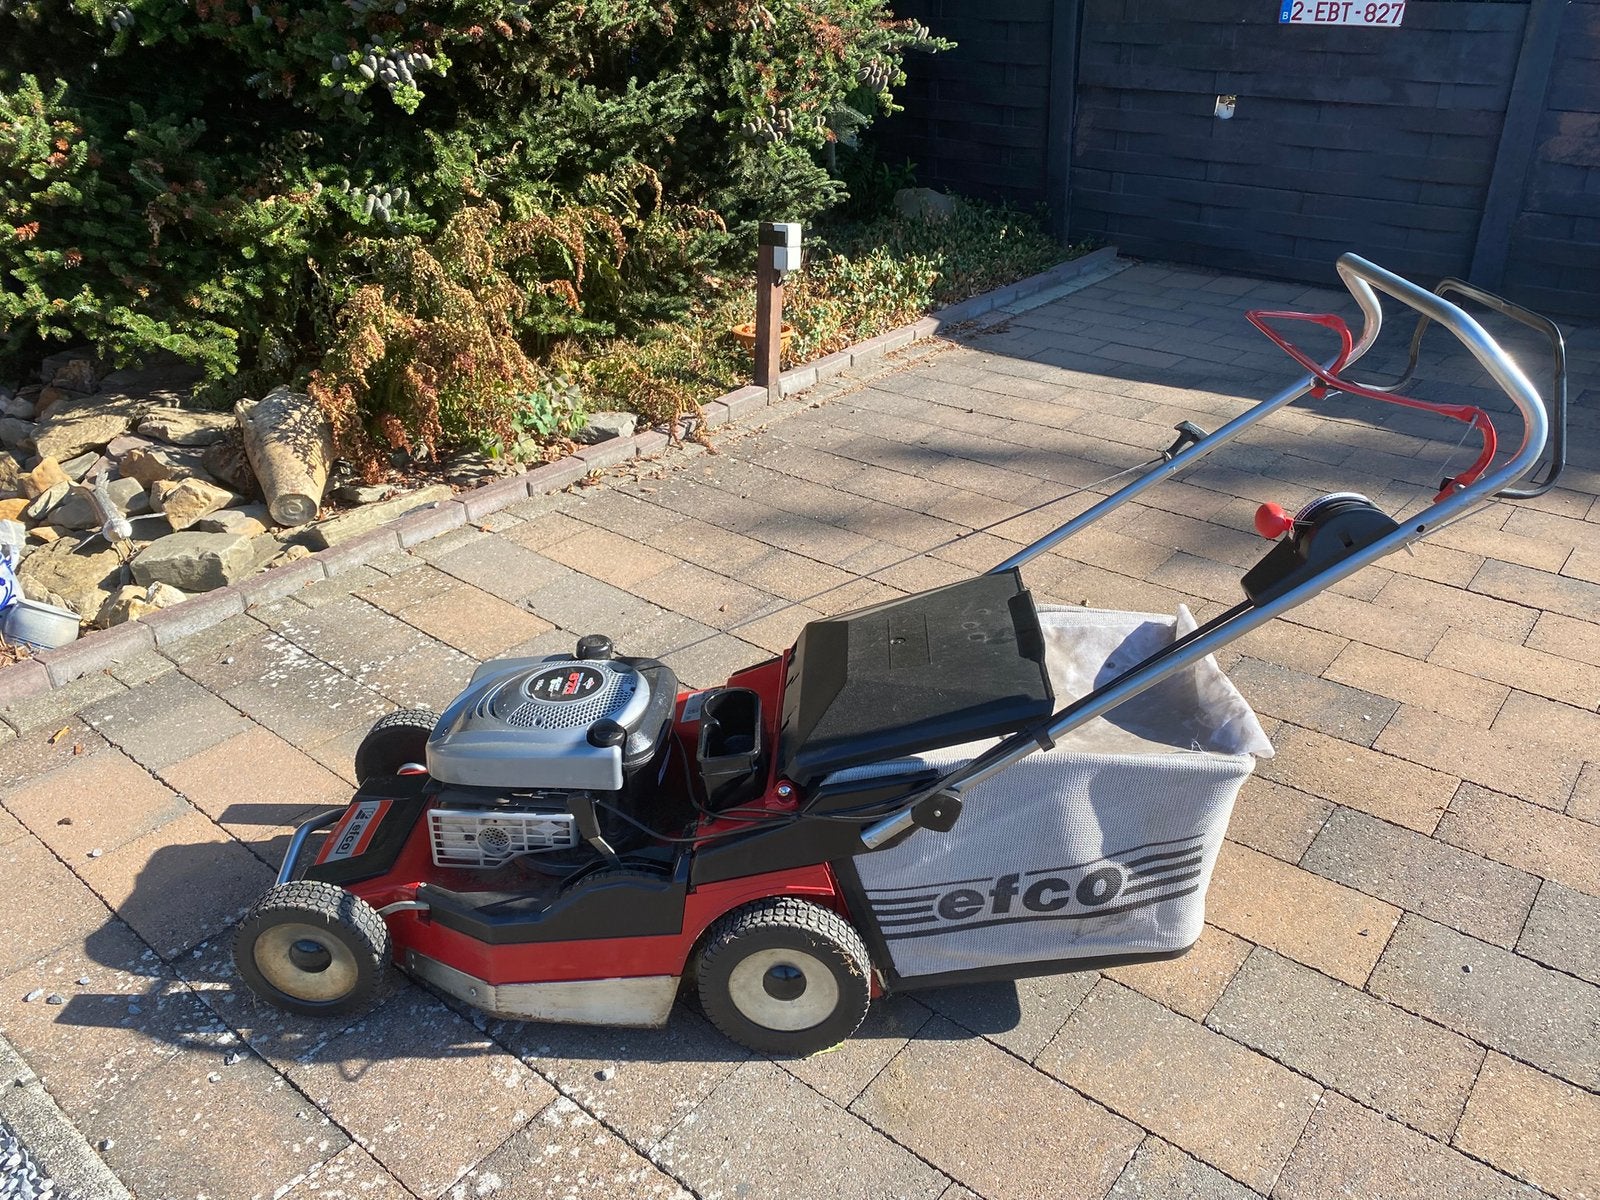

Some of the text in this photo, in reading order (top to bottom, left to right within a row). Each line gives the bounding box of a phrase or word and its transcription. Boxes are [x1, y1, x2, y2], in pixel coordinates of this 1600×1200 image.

[1291, 1, 1404, 24] 2-EBT-827
[341, 824, 361, 850] efco
[937, 866, 1124, 920] efco
